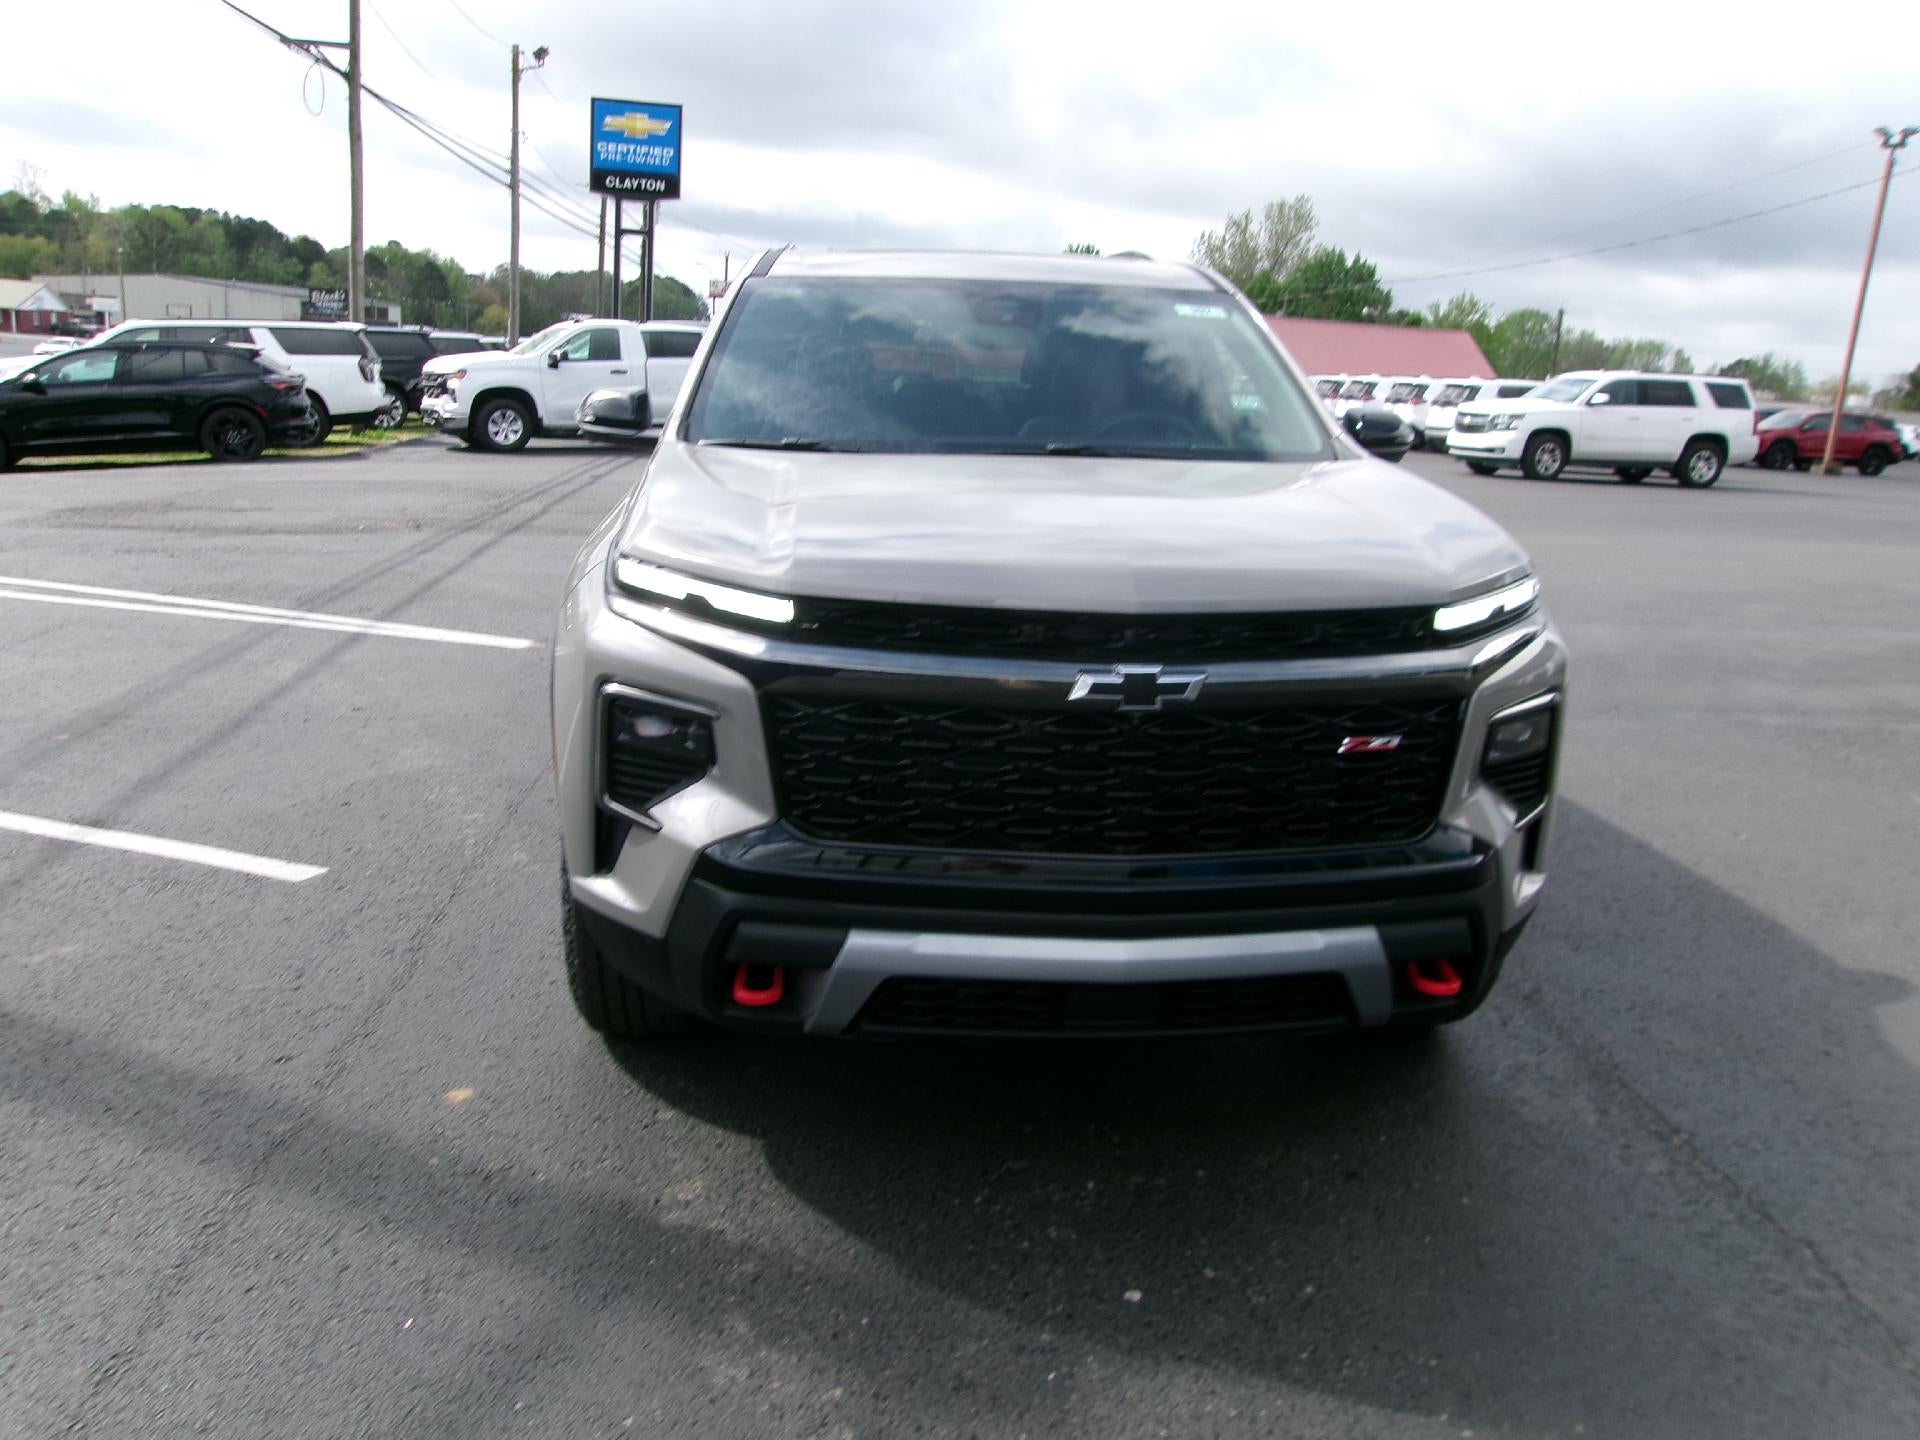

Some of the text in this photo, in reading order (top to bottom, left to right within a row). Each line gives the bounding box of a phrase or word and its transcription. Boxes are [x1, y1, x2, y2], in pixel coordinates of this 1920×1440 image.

[597, 141, 674, 158] CERTIFIED
[600, 152, 670, 166] PRE-OWNED
[605, 175, 666, 192] CLAYTON
